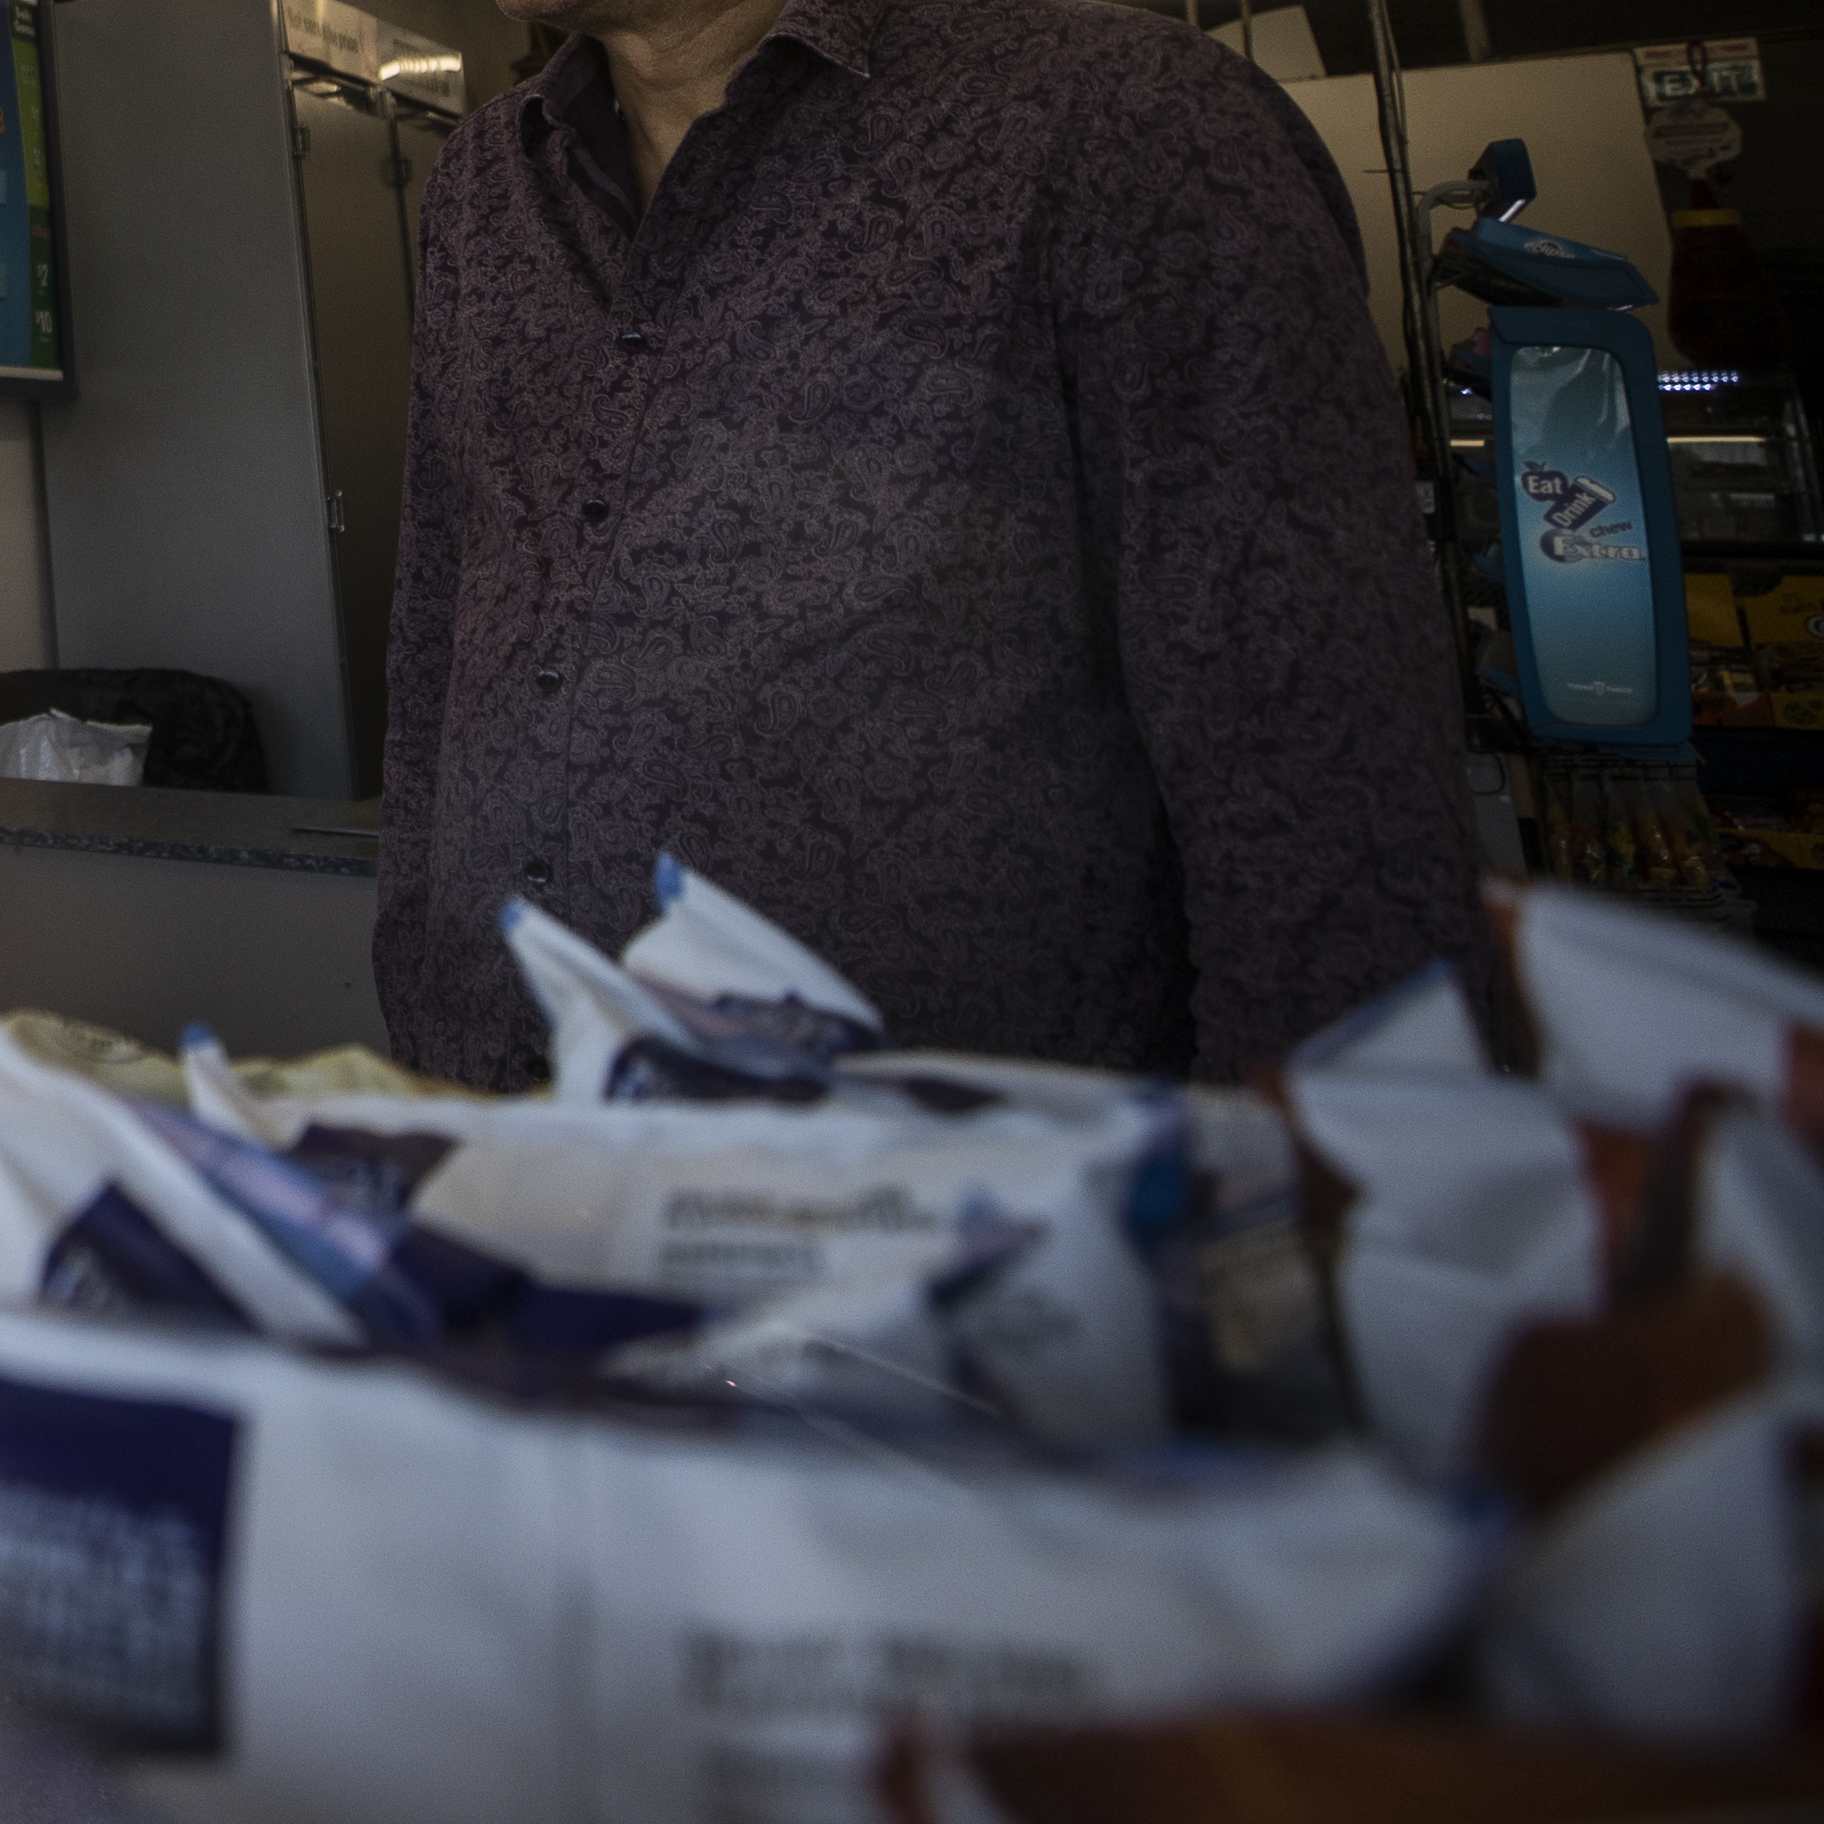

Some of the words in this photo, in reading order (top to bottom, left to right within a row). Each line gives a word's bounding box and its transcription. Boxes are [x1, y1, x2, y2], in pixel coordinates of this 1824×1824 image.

[1527, 475, 1562, 494] Eat
[1552, 492, 1596, 527] Drink
[1589, 521, 1632, 537] chew
[1553, 535, 1642, 561] Extra
